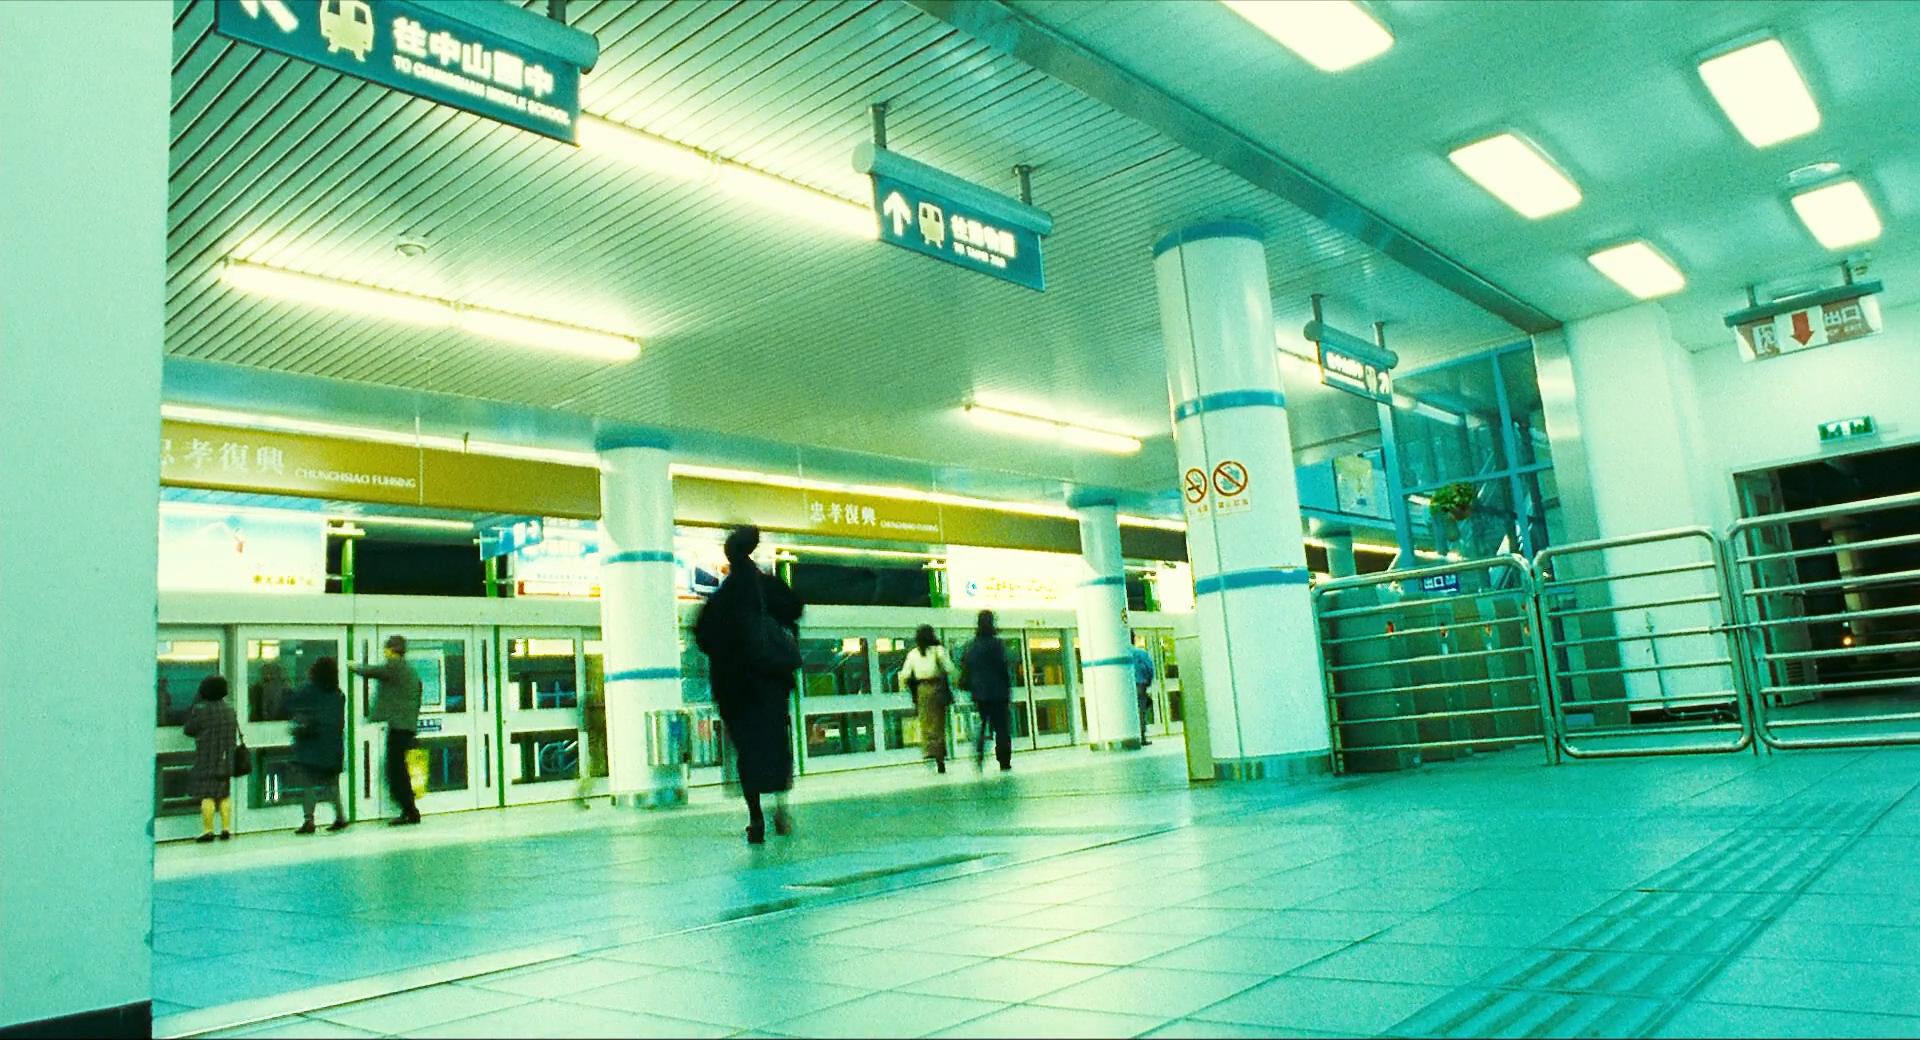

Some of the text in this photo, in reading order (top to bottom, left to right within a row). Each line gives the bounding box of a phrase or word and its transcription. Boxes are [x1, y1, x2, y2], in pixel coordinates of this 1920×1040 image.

[393, 54, 413, 75] TO
[527, 100, 571, 125] SCHOOL
[1823, 304, 1861, 326] 出口
